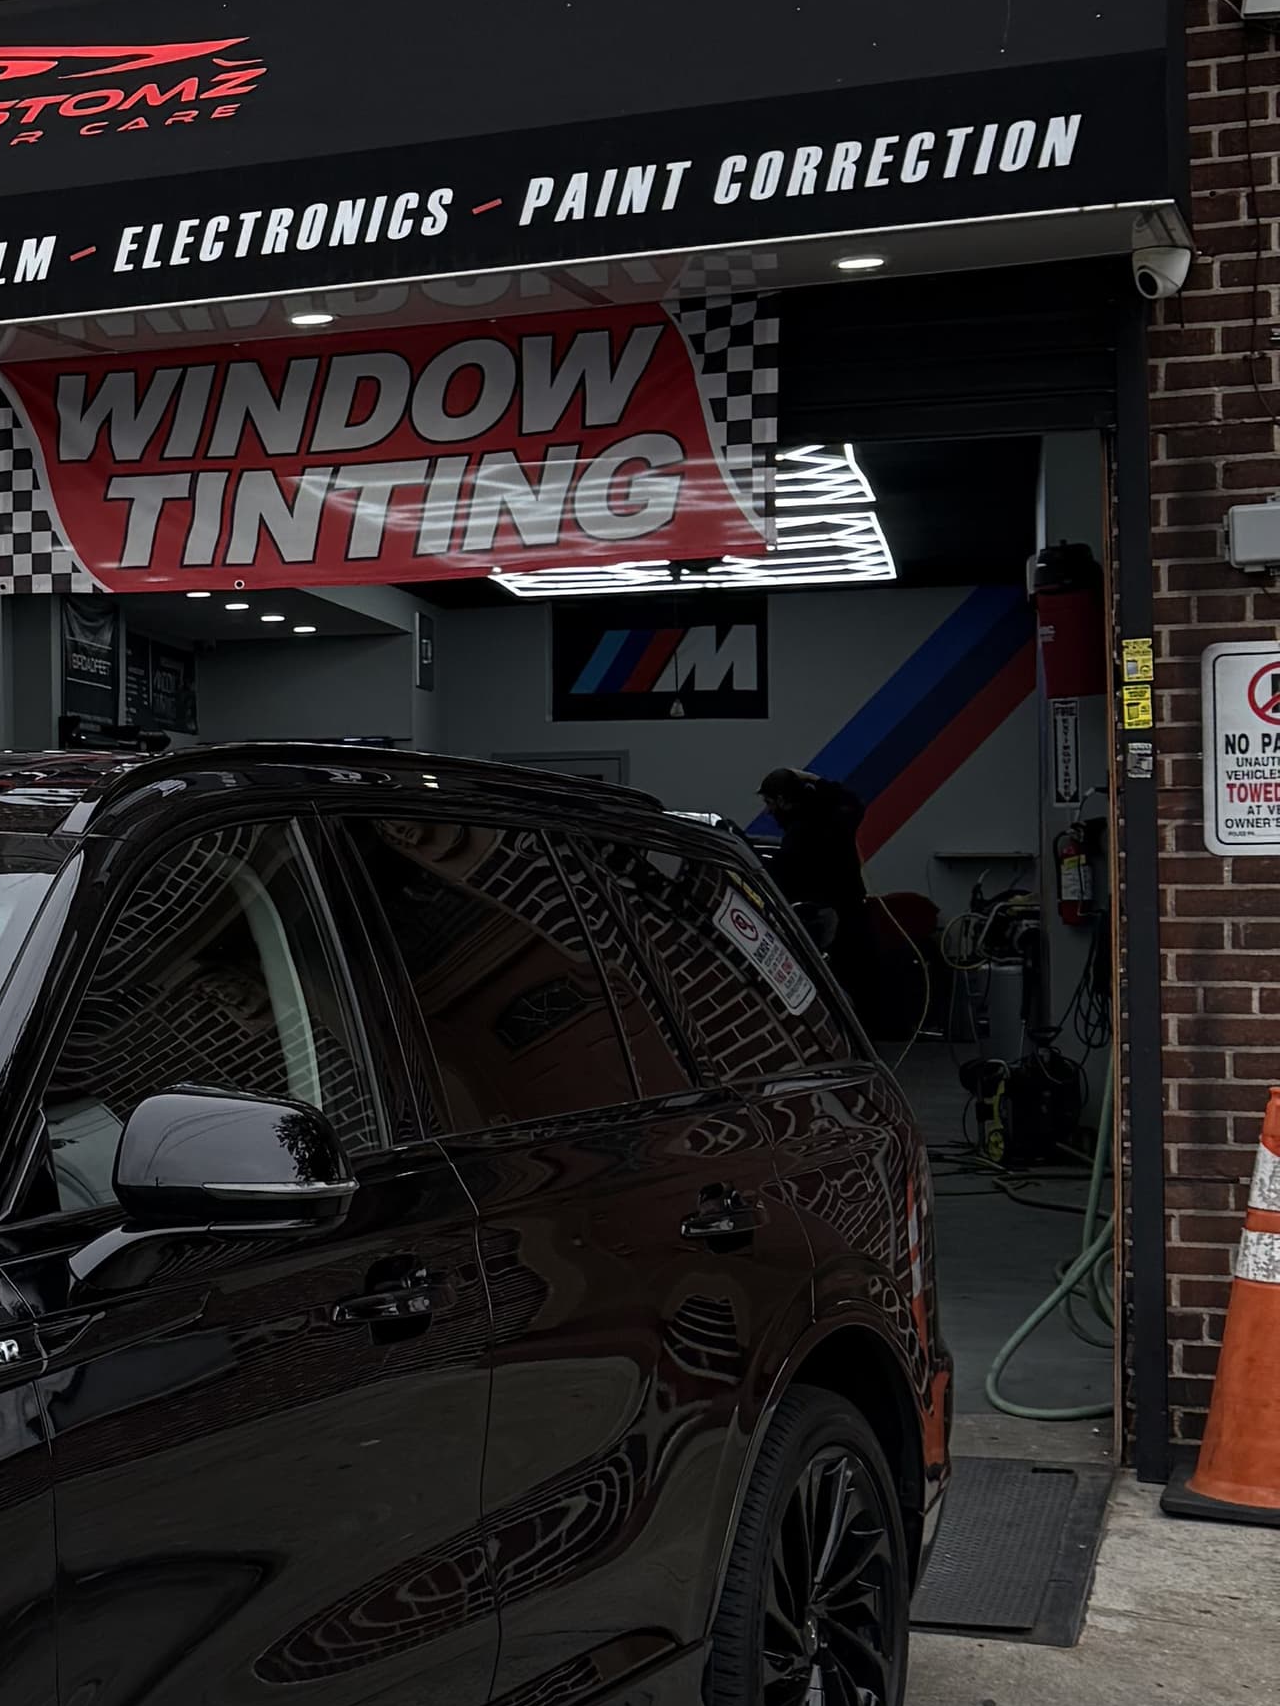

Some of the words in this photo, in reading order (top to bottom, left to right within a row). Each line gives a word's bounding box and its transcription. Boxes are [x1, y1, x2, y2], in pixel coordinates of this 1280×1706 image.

[81, 103, 242, 135] CARE
[113, 187, 454, 273] ELECTRONICS
[517, 161, 691, 226] PAINT
[712, 114, 1083, 204] CORRECTION
[56, 324, 666, 462] WINDOW
[106, 432, 686, 569] TINTING
[648, 624, 758, 693] M
[1225, 733, 1249, 755] NO
[1247, 805, 1262, 815] AT
